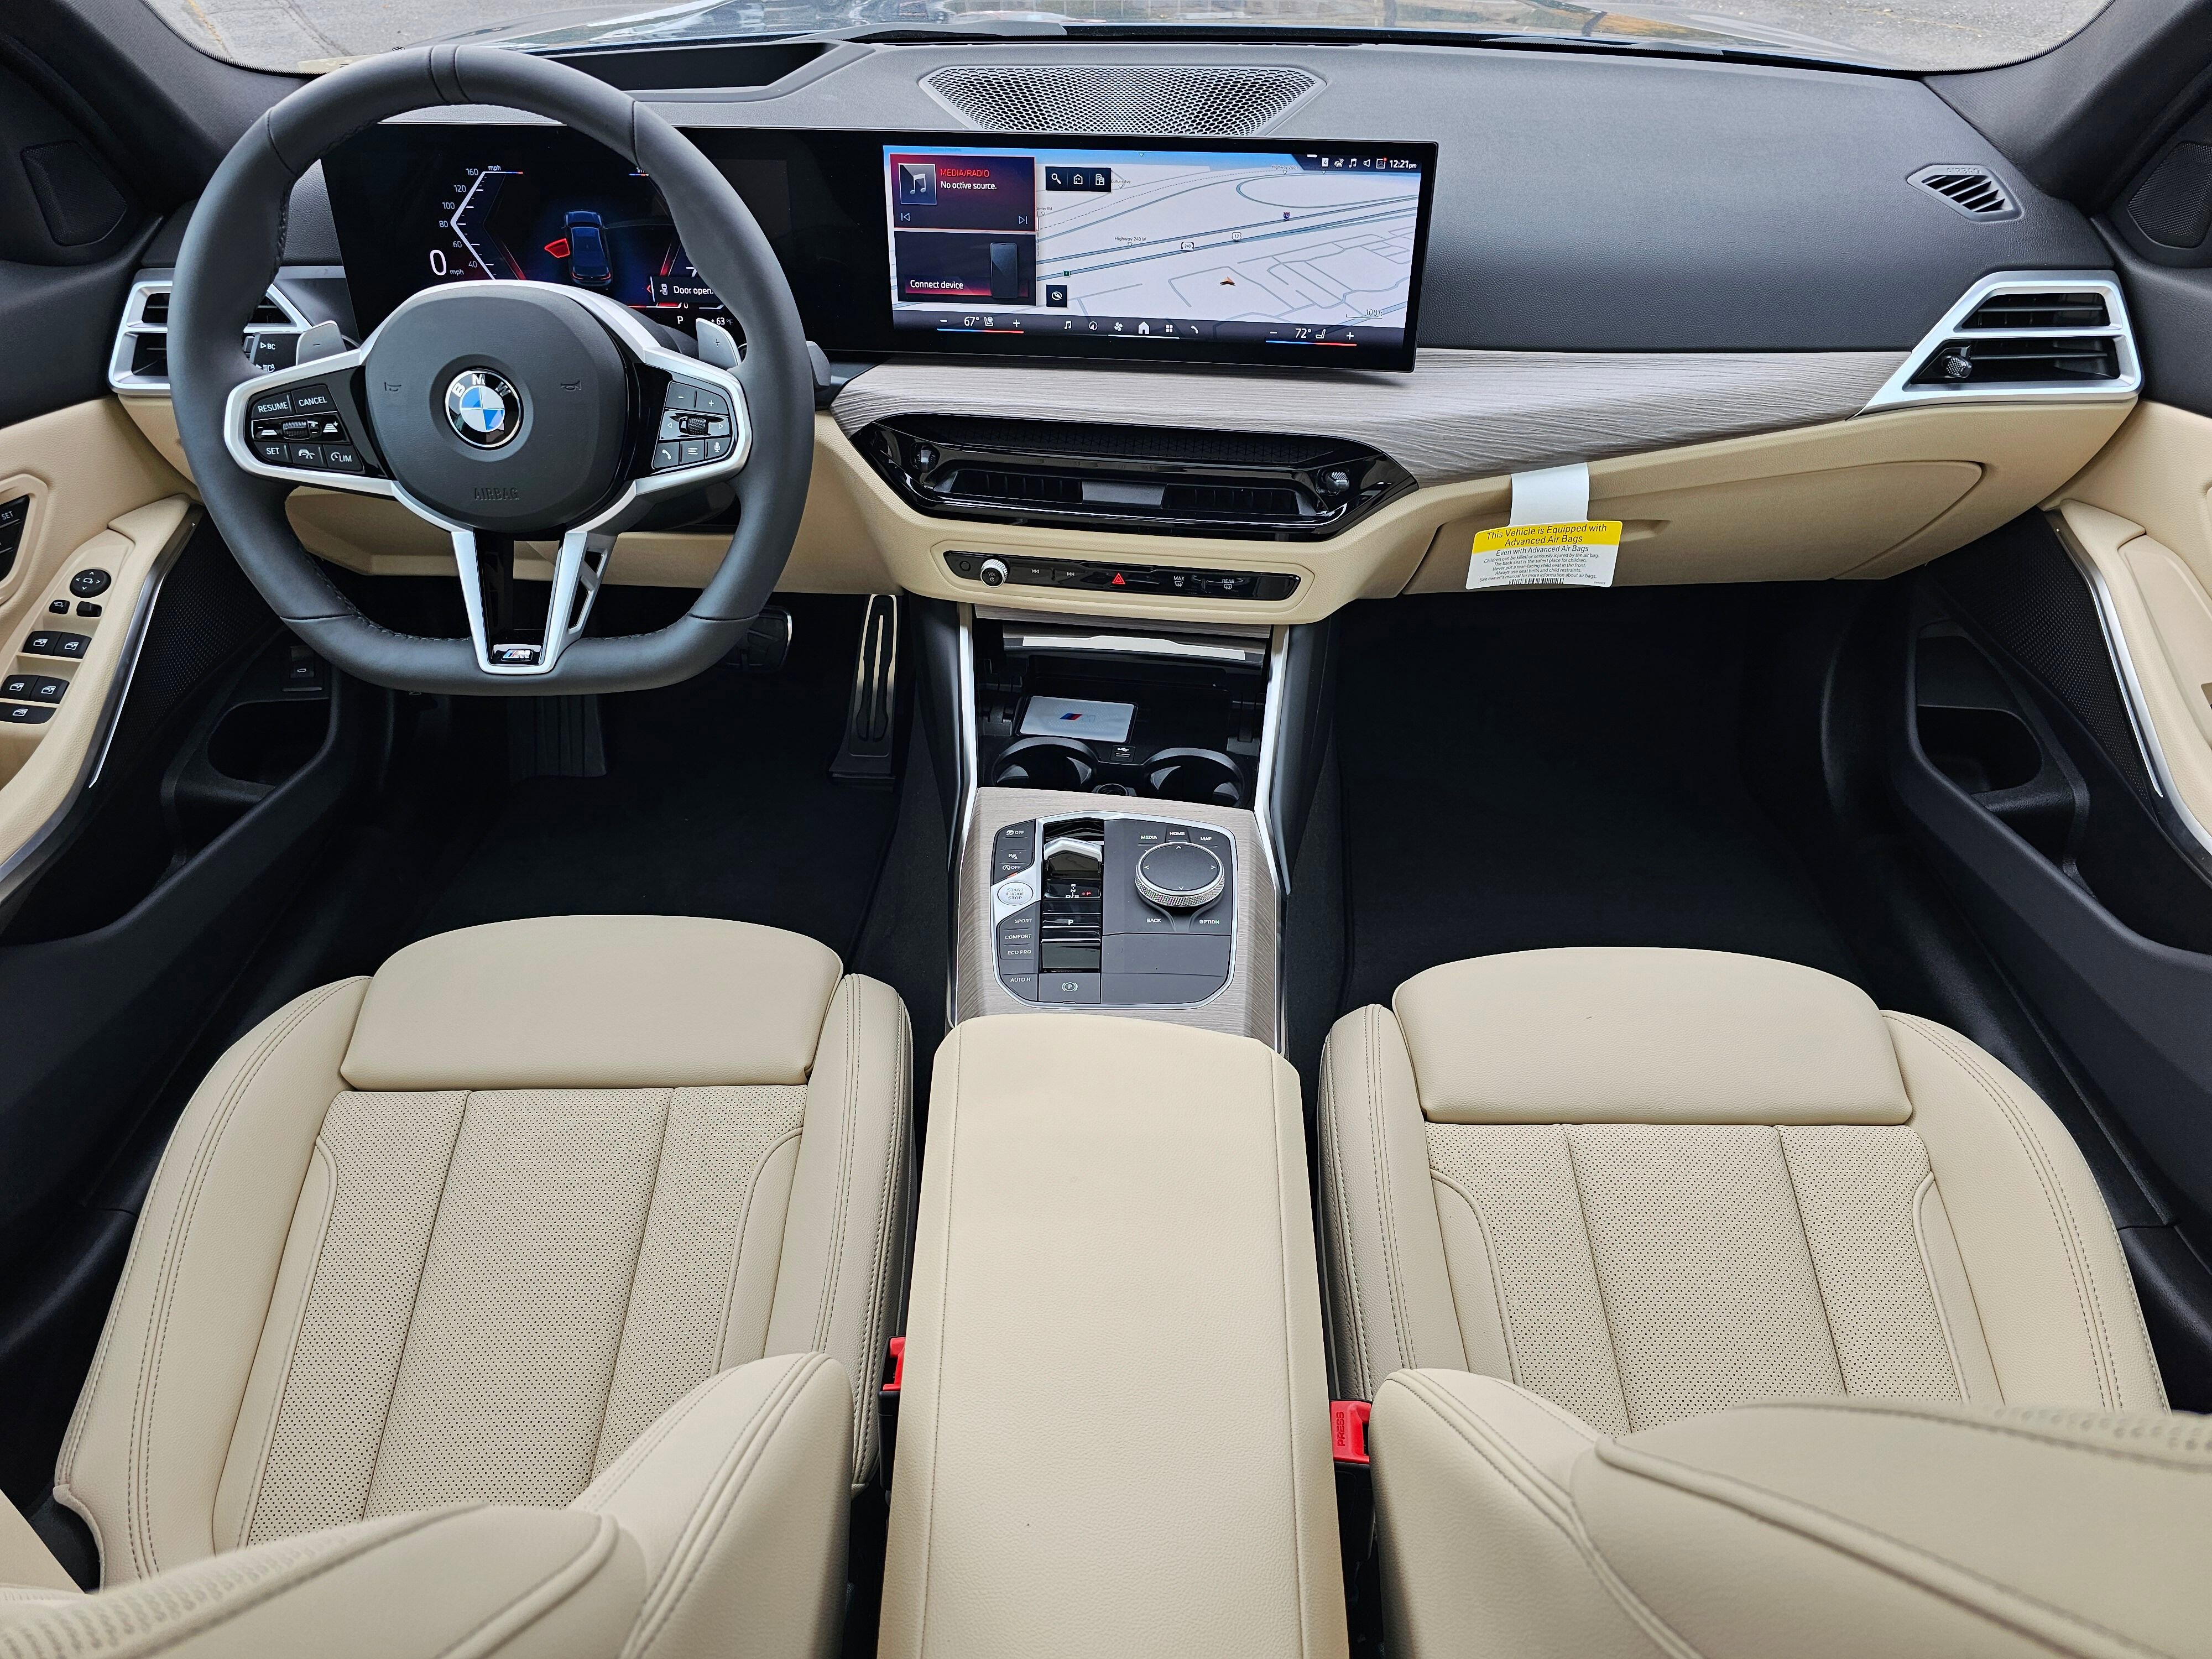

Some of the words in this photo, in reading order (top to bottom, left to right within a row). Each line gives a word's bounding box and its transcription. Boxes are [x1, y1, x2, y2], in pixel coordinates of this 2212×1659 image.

[940, 169, 990, 178] MEDIA/RADIO
[430, 249, 447, 275] 0
[910, 280, 940, 289] Connect
[941, 281, 964, 289] device
[673, 286, 691, 294] Door
[677, 316, 684, 325] P
[452, 373, 512, 399] BMW
[299, 396, 328, 406] CANCEL
[258, 402, 289, 413] RESUME
[474, 487, 520, 500] AIRBAG
[1, 510, 14, 520] SET
[1486, 531, 1503, 540] This
[1506, 526, 1536, 537] Vehicle
[1537, 526, 1545, 535] is
[1547, 524, 1587, 535] Equipped
[1589, 524, 1606, 532] with
[1505, 536, 1546, 546] Advanced
[1561, 535, 1583, 544] Bags
[1528, 545, 1560, 554] Advanced
[1572, 545, 1589, 553] Bags
[1335, 1411, 1345, 1447] PRESS
